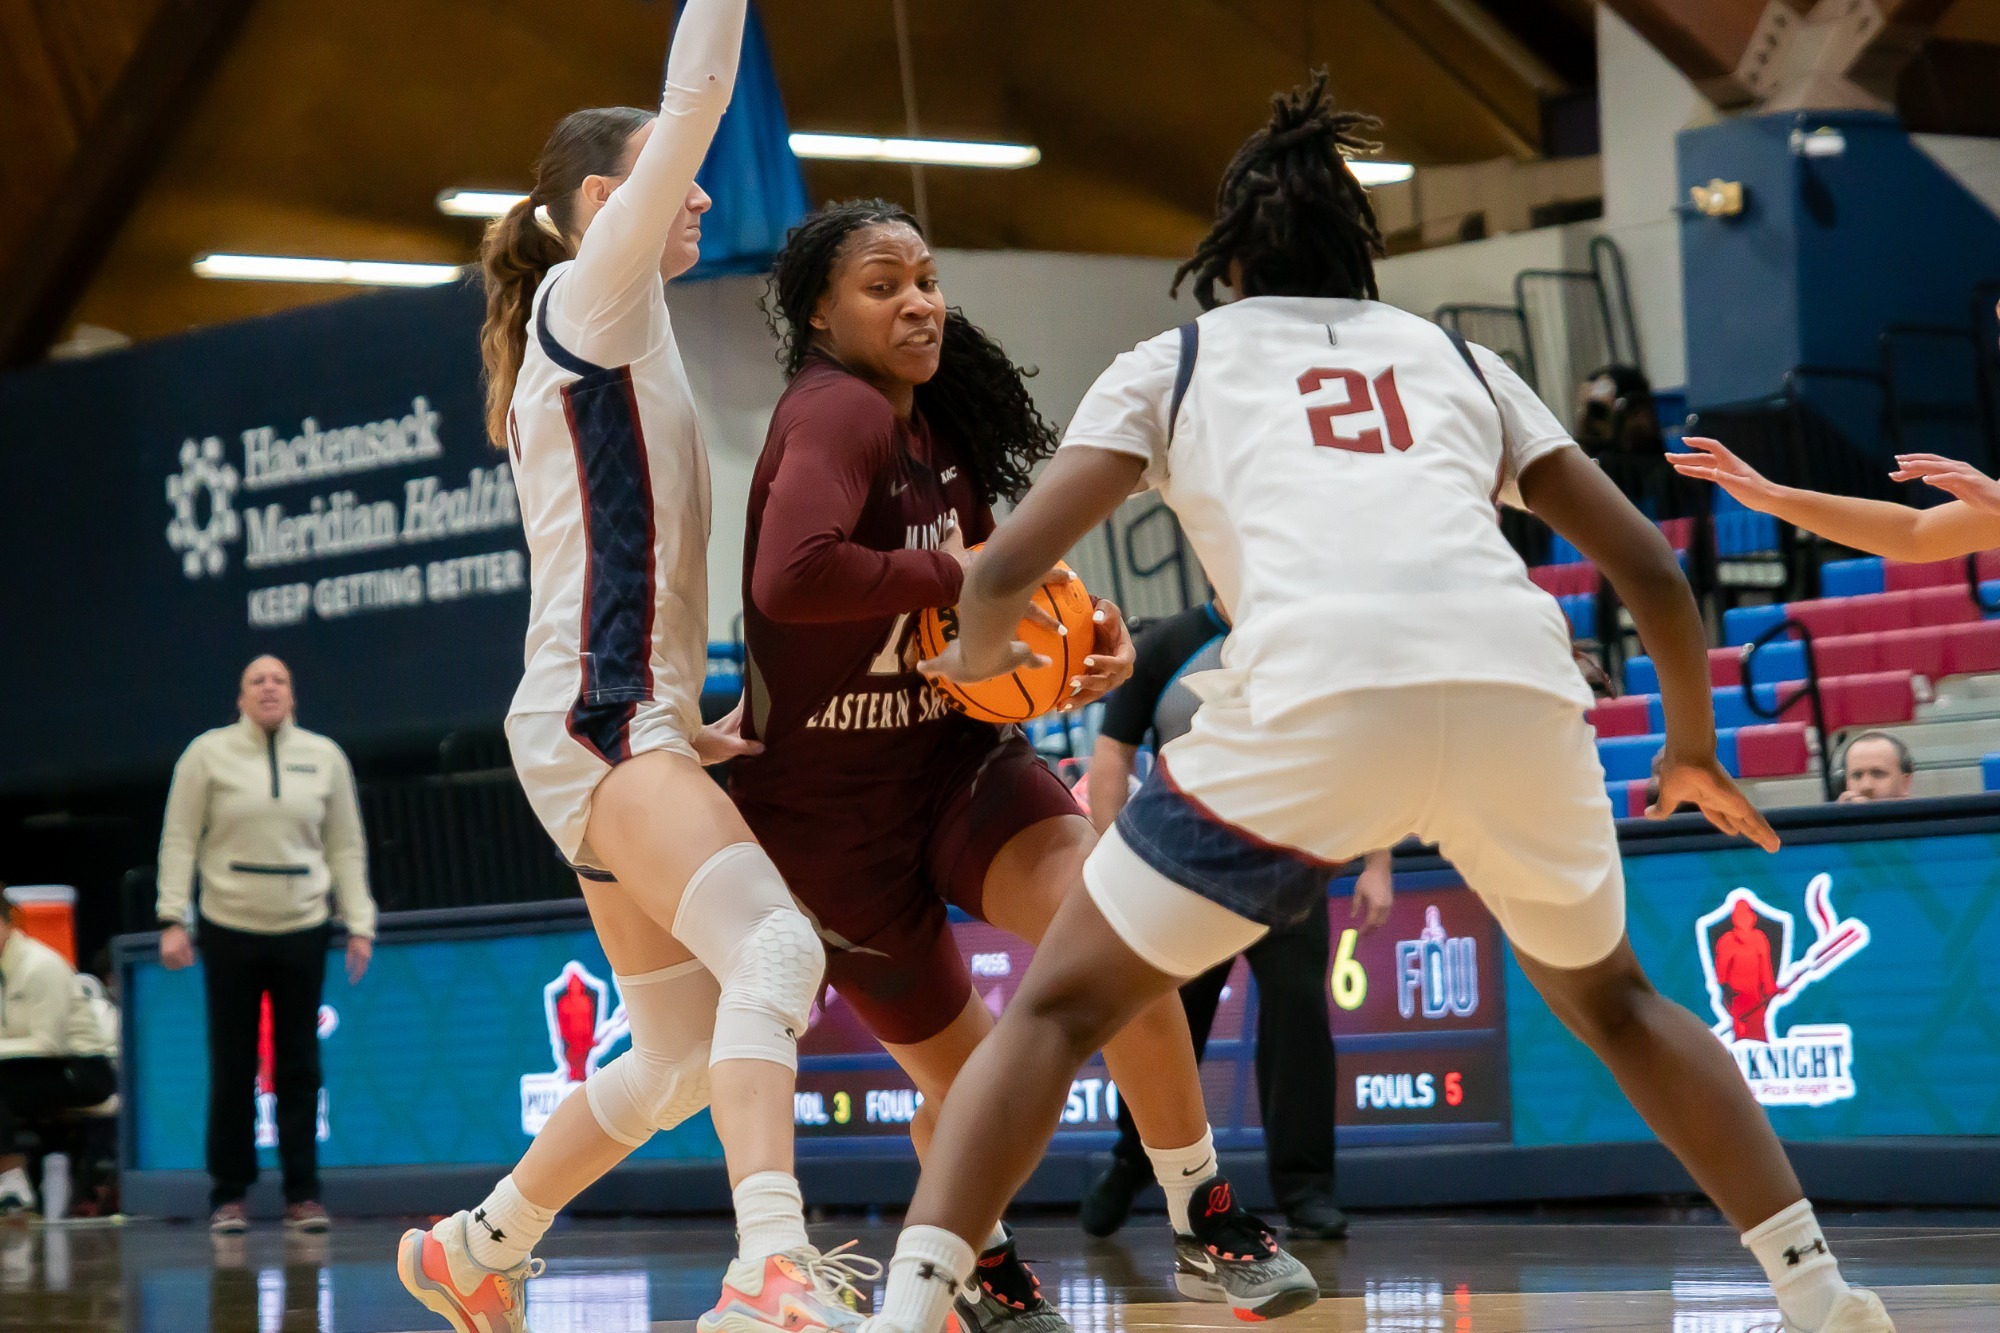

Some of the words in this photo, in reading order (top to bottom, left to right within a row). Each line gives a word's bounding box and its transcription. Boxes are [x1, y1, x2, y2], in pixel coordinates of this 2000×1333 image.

[241, 395, 444, 490] Hackensack
[1296, 364, 1414, 454] 21
[243, 490, 401, 569] Meridian
[401, 462, 519, 544] Health
[247, 582, 310, 629] KEEP
[313, 564, 424, 620] GETTING
[426, 548, 525, 601] BETTER
[971, 952, 1012, 976] POSS
[1331, 928, 1368, 1011] 6
[1395, 936, 1478, 1019] FDU
[833, 1091, 851, 1124] 3
[1059, 1078, 1103, 1124] ST
[1355, 1072, 1437, 1110] FOULS
[1444, 1071, 1464, 1107] 5
